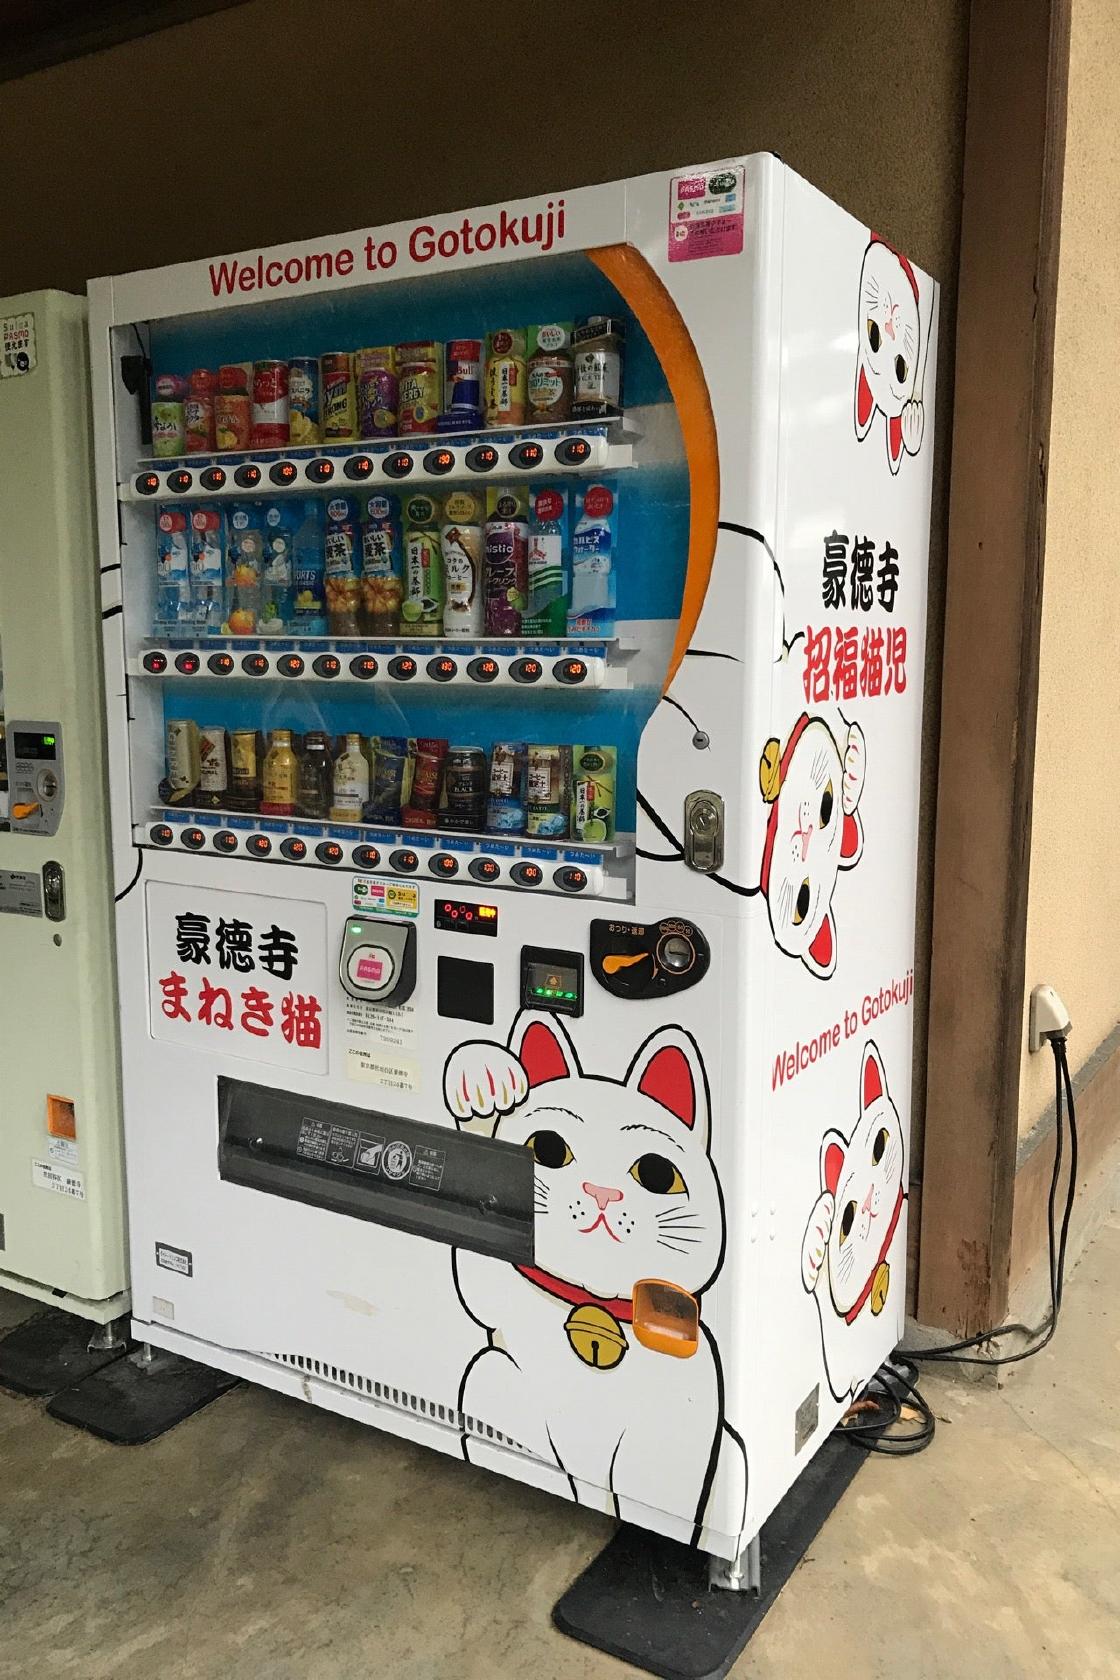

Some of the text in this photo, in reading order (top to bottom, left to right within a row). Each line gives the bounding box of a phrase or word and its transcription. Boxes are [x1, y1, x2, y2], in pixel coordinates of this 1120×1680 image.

[209, 199, 565, 297] Welcome to Gotokuji
[822, 528, 900, 613] 豪徳寺
[802, 624, 908, 704] 招福猫児
[175, 911, 299, 981] 豪徳寺
[158, 970, 323, 1050] まねき猫
[771, 968, 914, 1093] Welcome to Gotokuji
